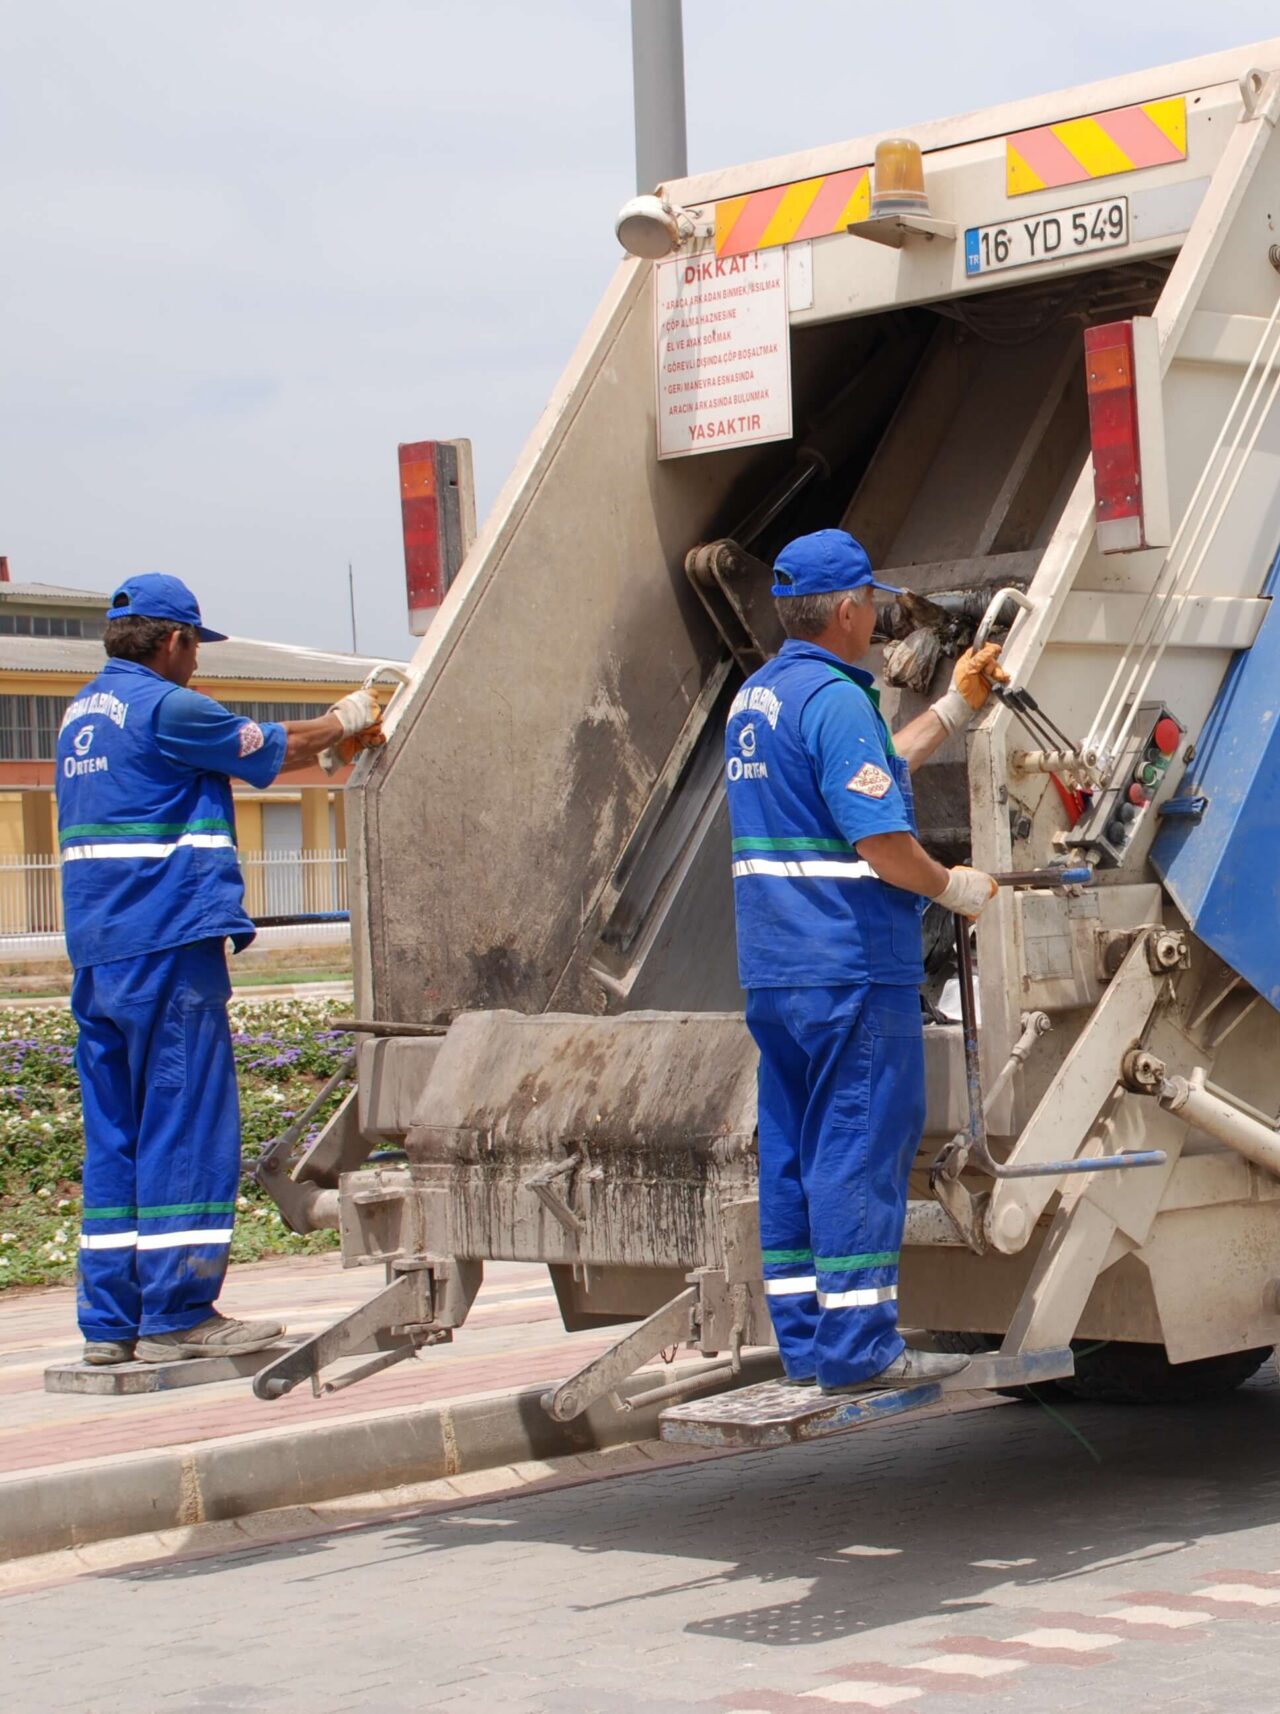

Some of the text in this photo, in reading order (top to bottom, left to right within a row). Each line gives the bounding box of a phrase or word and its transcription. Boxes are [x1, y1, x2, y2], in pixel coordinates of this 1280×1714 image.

[981, 204, 1123, 266] 16 YD 549
[969, 254, 980, 266] TR
[689, 291, 721, 306] ARKADAN
[667, 341, 675, 351] EL
[676, 340, 685, 350] VE
[686, 336, 702, 349] AYAK
[684, 376, 716, 391] MANEVRA
[717, 370, 755, 386] ESNASINDA
[733, 389, 769, 404] BULUNMAK
[688, 414, 761, 441] YASAKTIR
